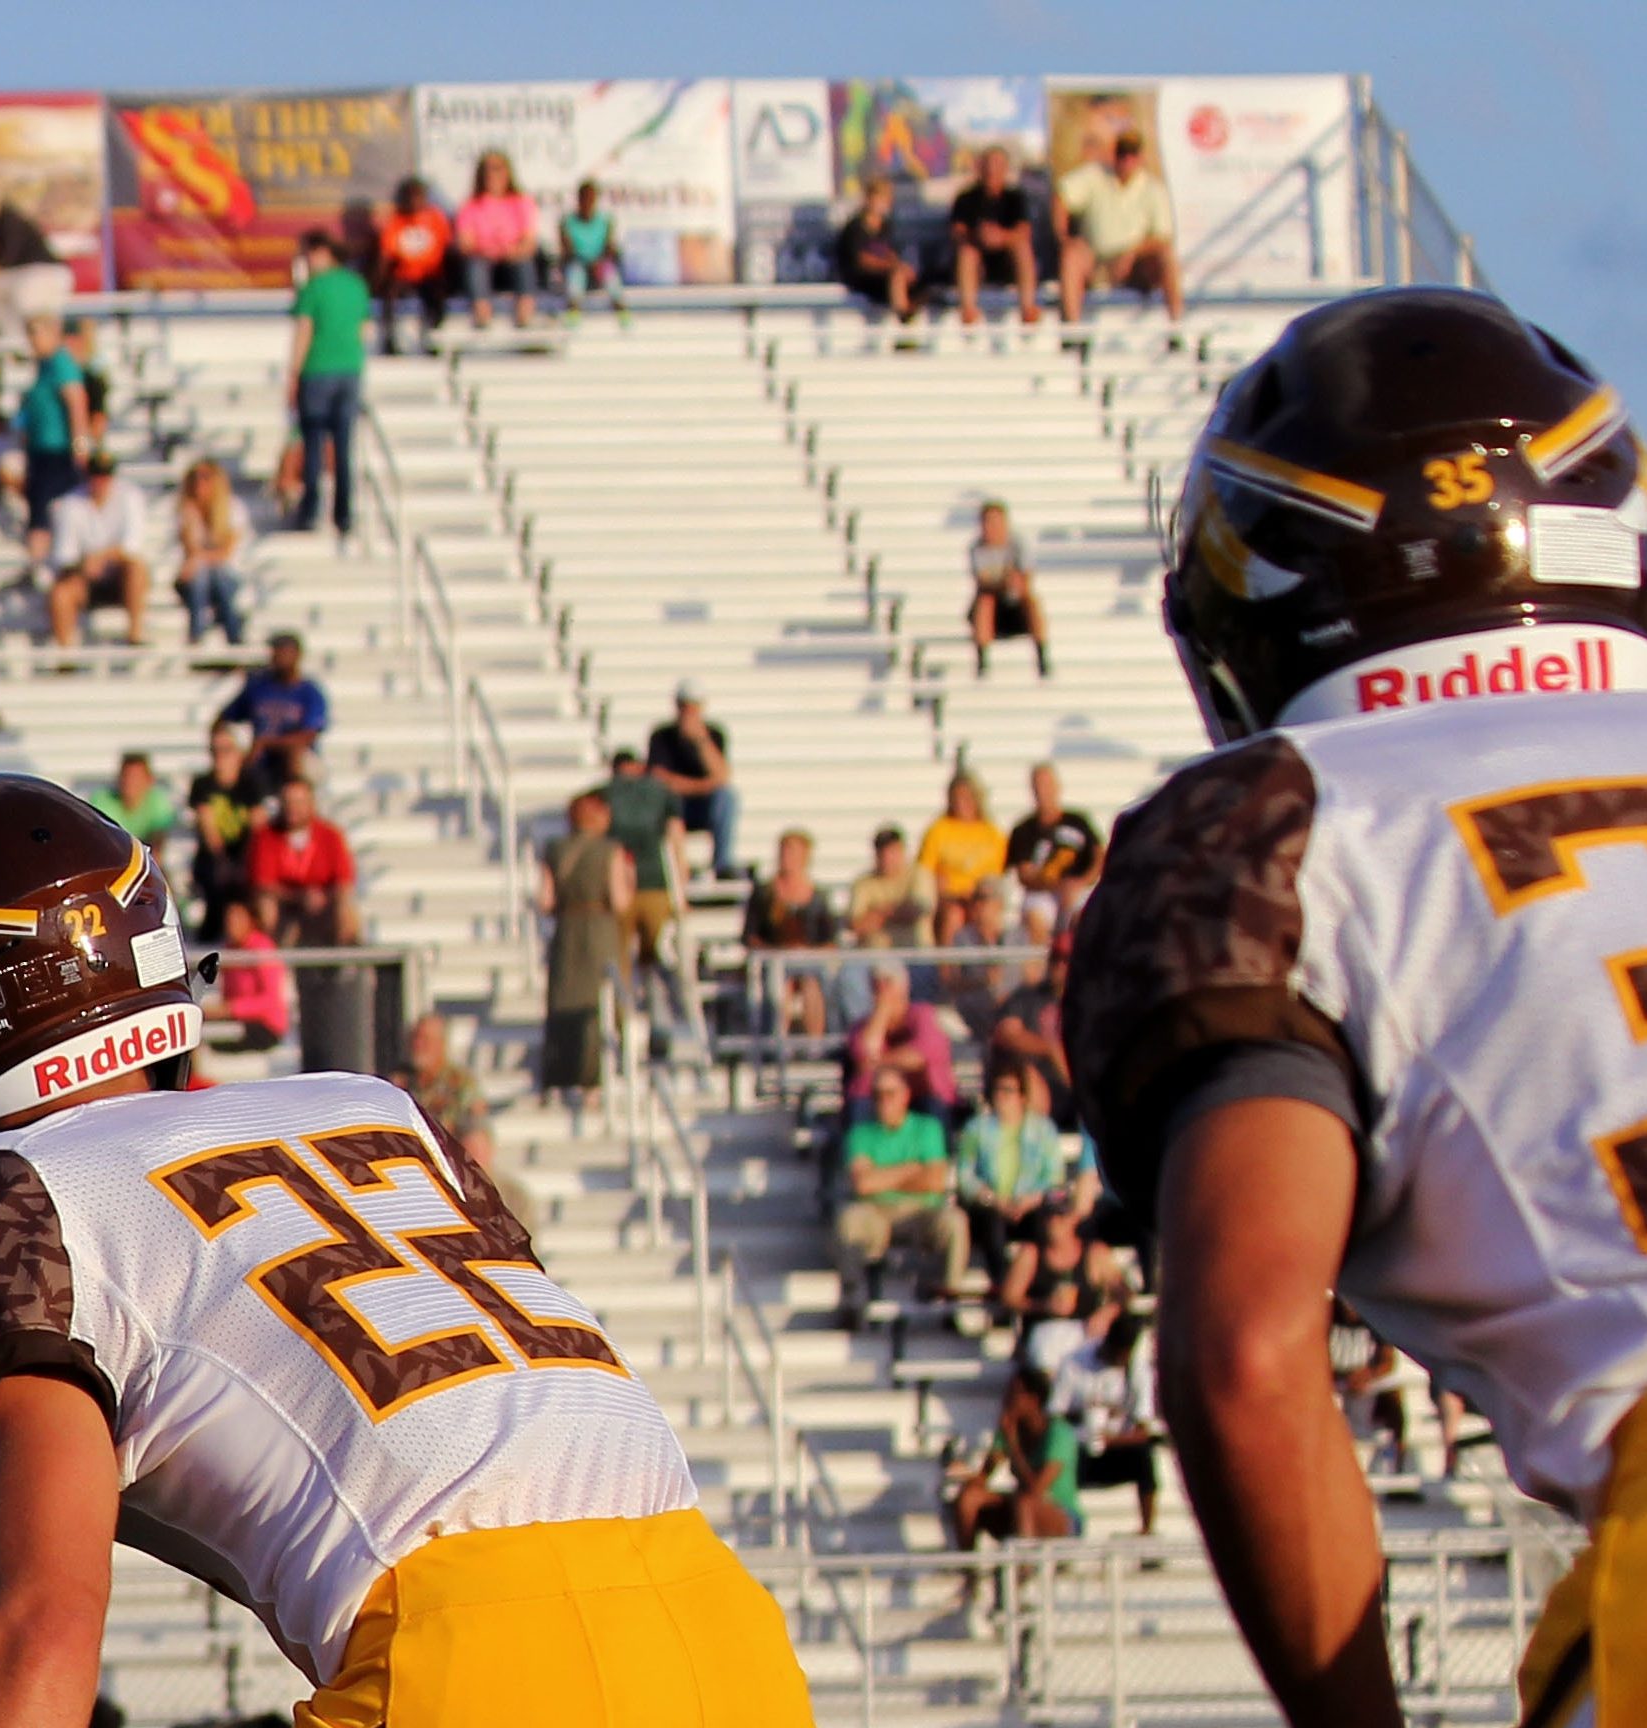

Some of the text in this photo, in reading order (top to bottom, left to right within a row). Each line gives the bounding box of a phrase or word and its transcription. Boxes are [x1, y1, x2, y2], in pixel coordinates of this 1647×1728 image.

[426, 87, 577, 130] Amazing
[1421, 450, 1496, 511] 35
[1357, 638, 1614, 713] Riddell
[63, 903, 106, 945] 22
[32, 1010, 188, 1098] Riddell
[146, 1123, 632, 1425] 22
